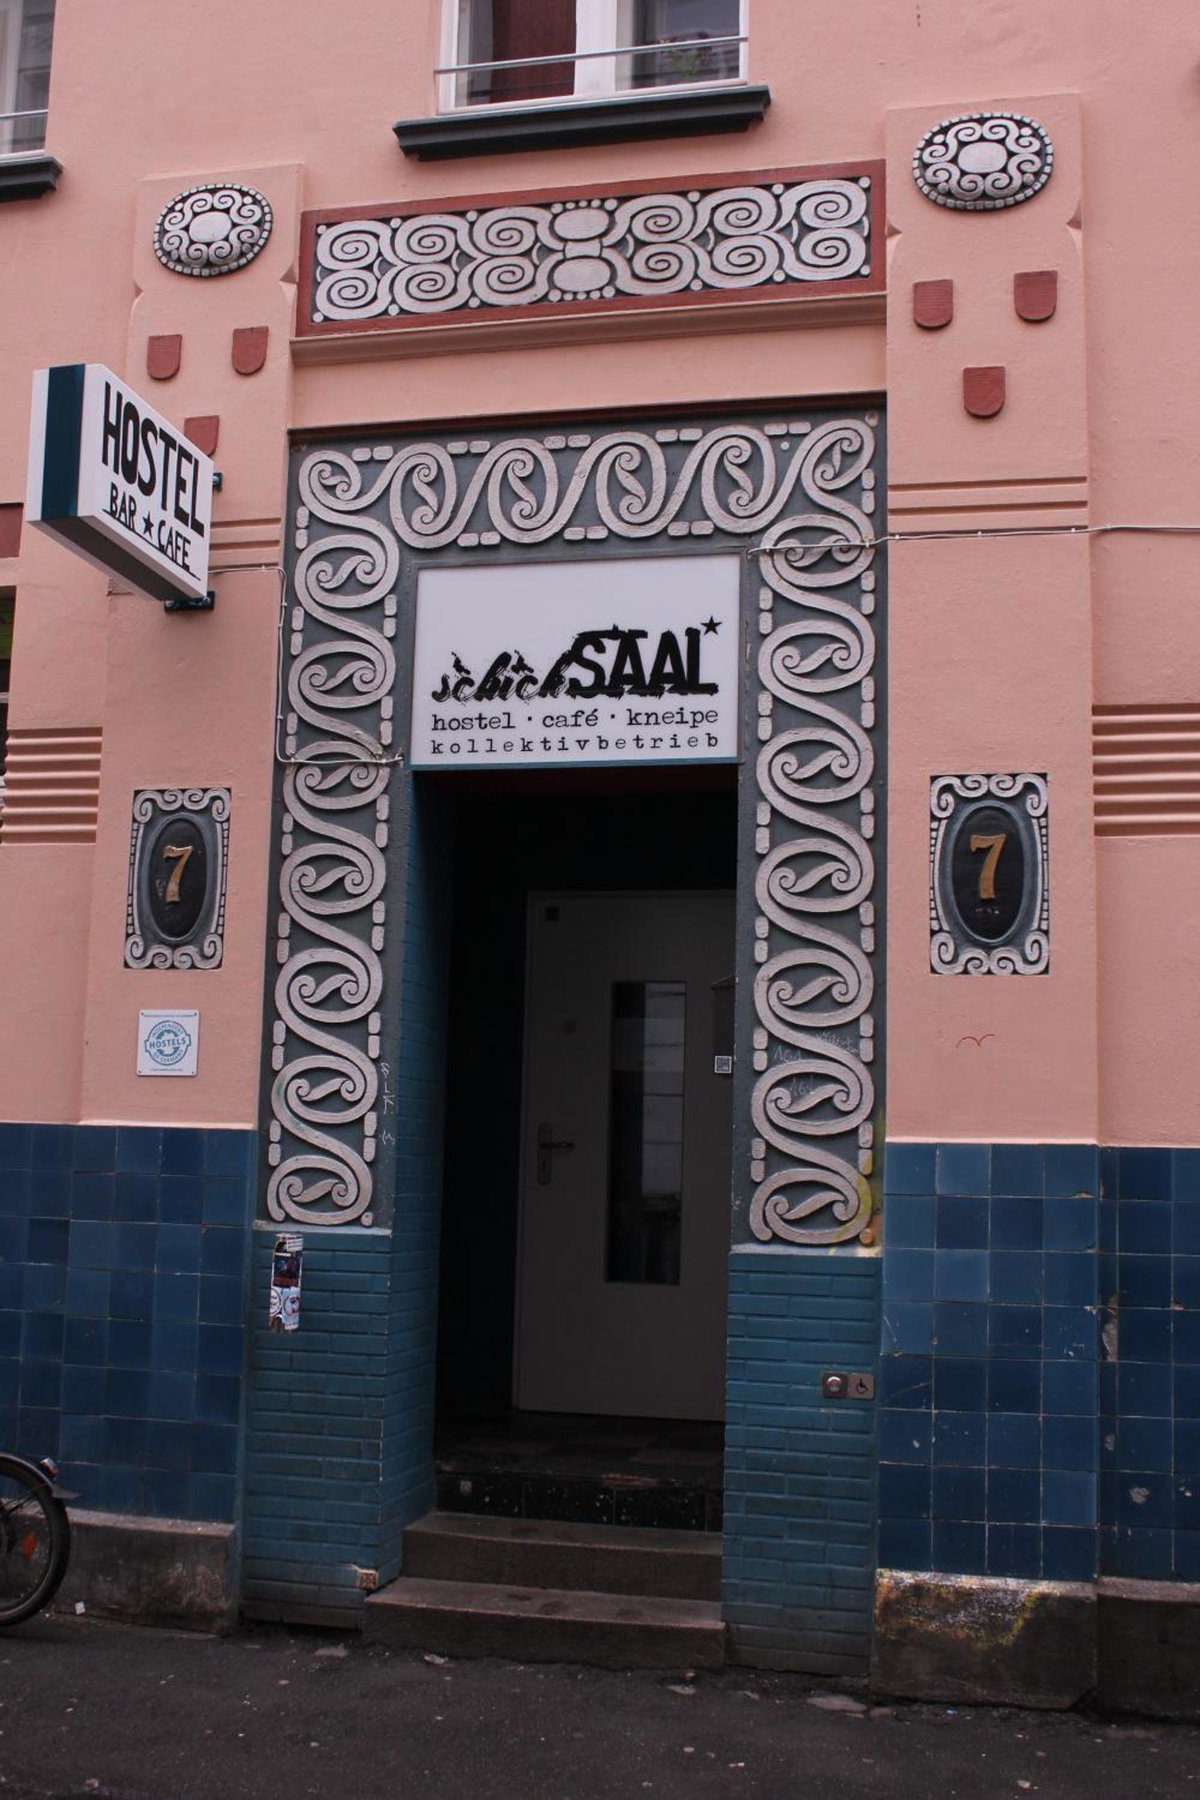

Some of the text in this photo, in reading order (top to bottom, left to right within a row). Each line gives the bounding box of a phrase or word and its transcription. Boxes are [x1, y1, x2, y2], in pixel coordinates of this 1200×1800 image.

[102, 381, 204, 537] HOSTEL
[110, 482, 191, 572] BAR CAFE
[431, 707, 719, 731] hostel café kneipe
[431, 733, 719, 755] kollektivbetrieb
[163, 845, 192, 903] 7
[970, 833, 1006, 899] 7
[149, 1036, 187, 1049] HOSTELS
